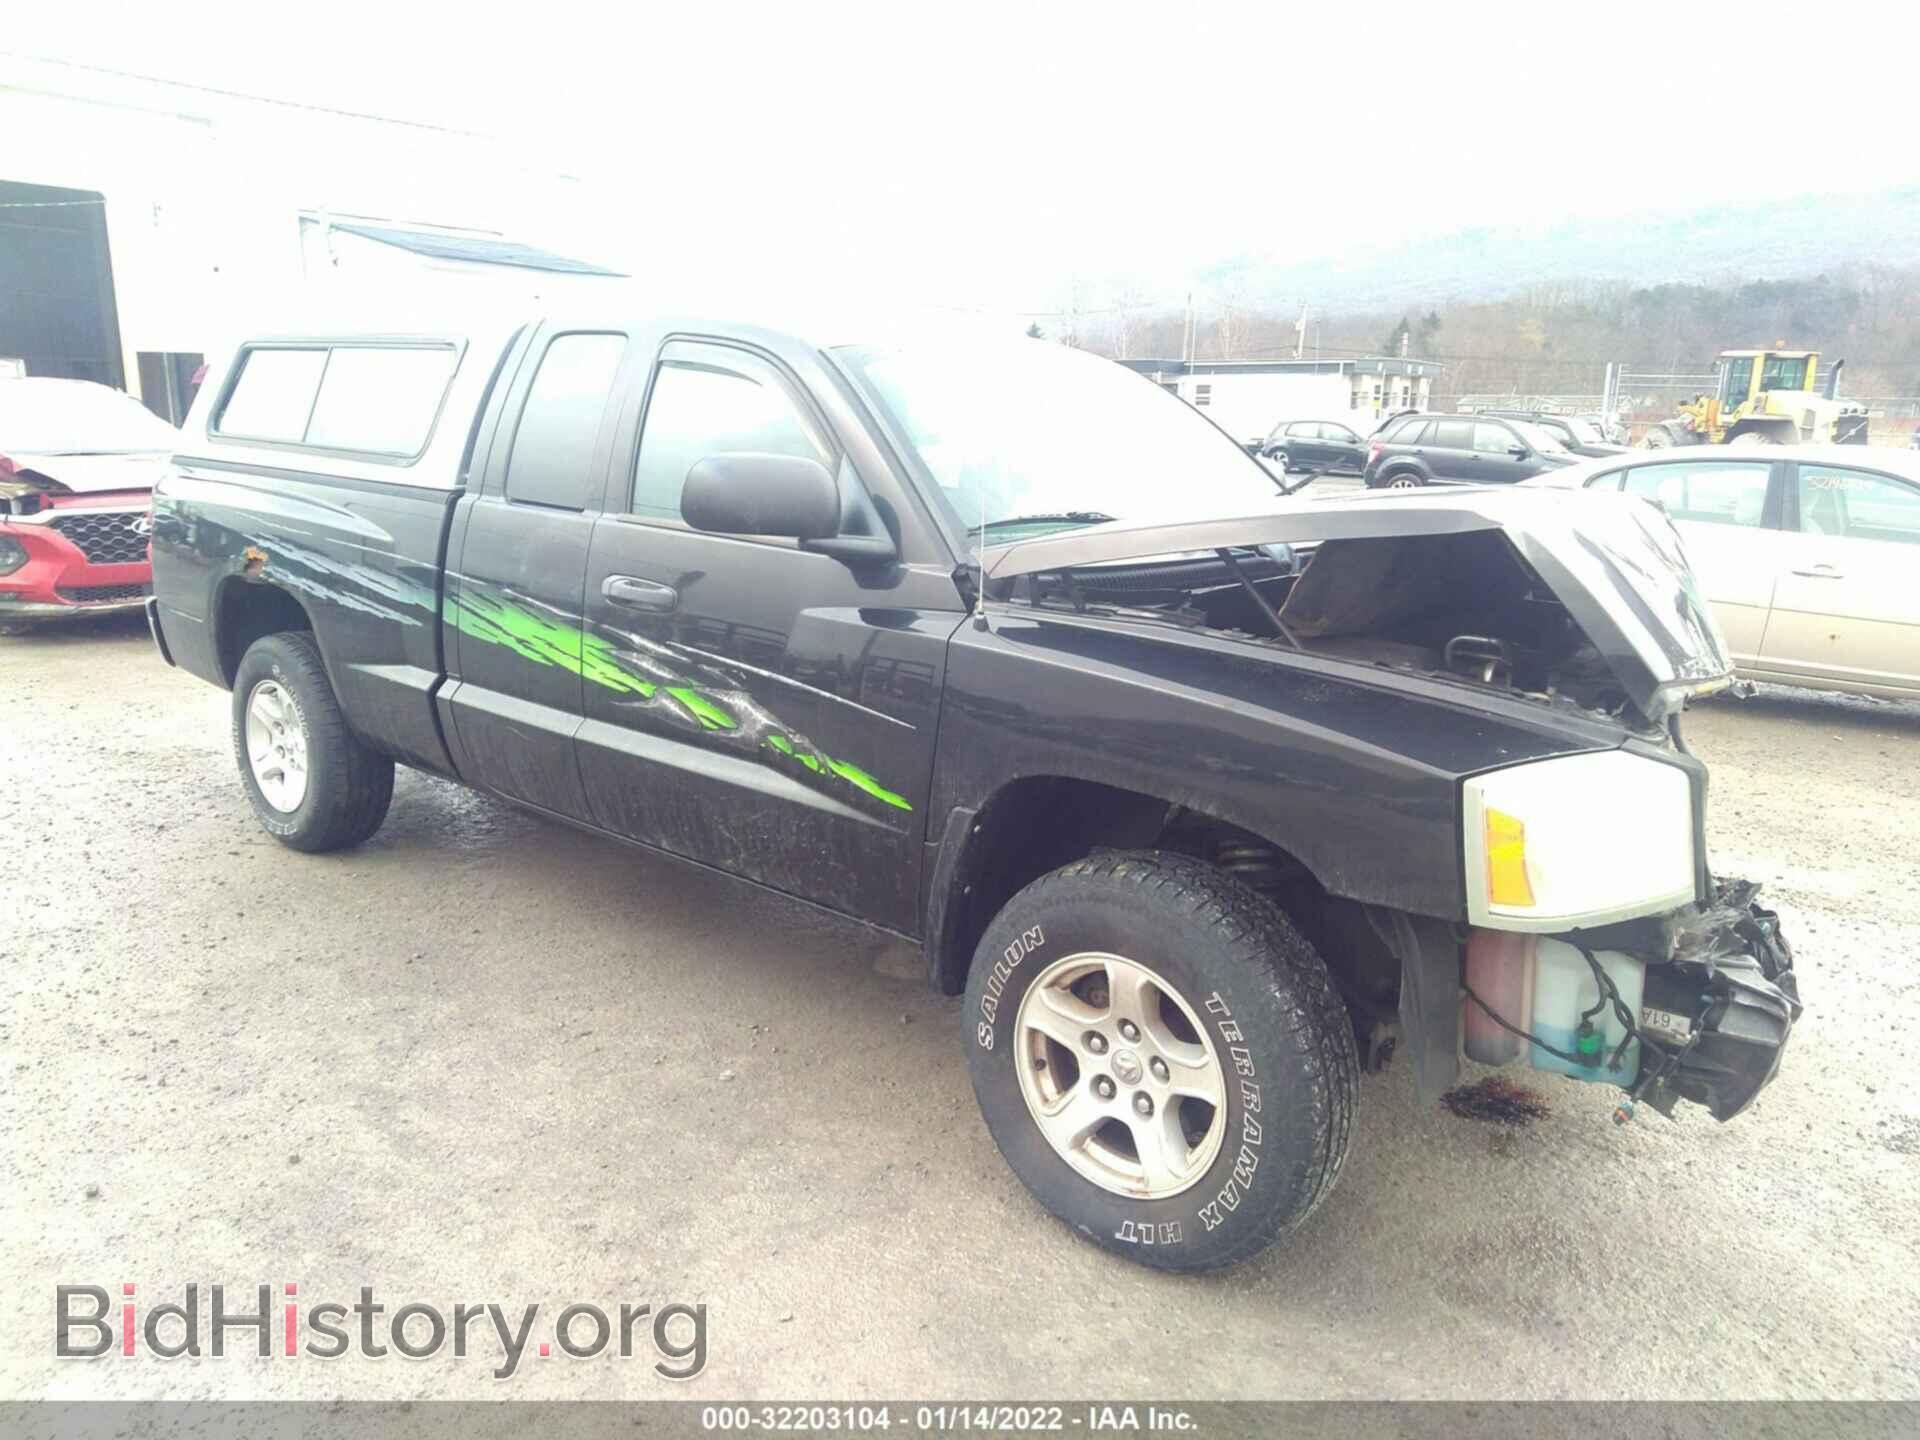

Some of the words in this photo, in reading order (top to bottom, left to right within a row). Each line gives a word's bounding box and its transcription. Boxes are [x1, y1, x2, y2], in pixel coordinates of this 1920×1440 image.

[977, 925, 1045, 1050] SAILUN
[1198, 992, 1264, 1231] TERRAMAX
[1114, 1220, 1183, 1244] HLT
